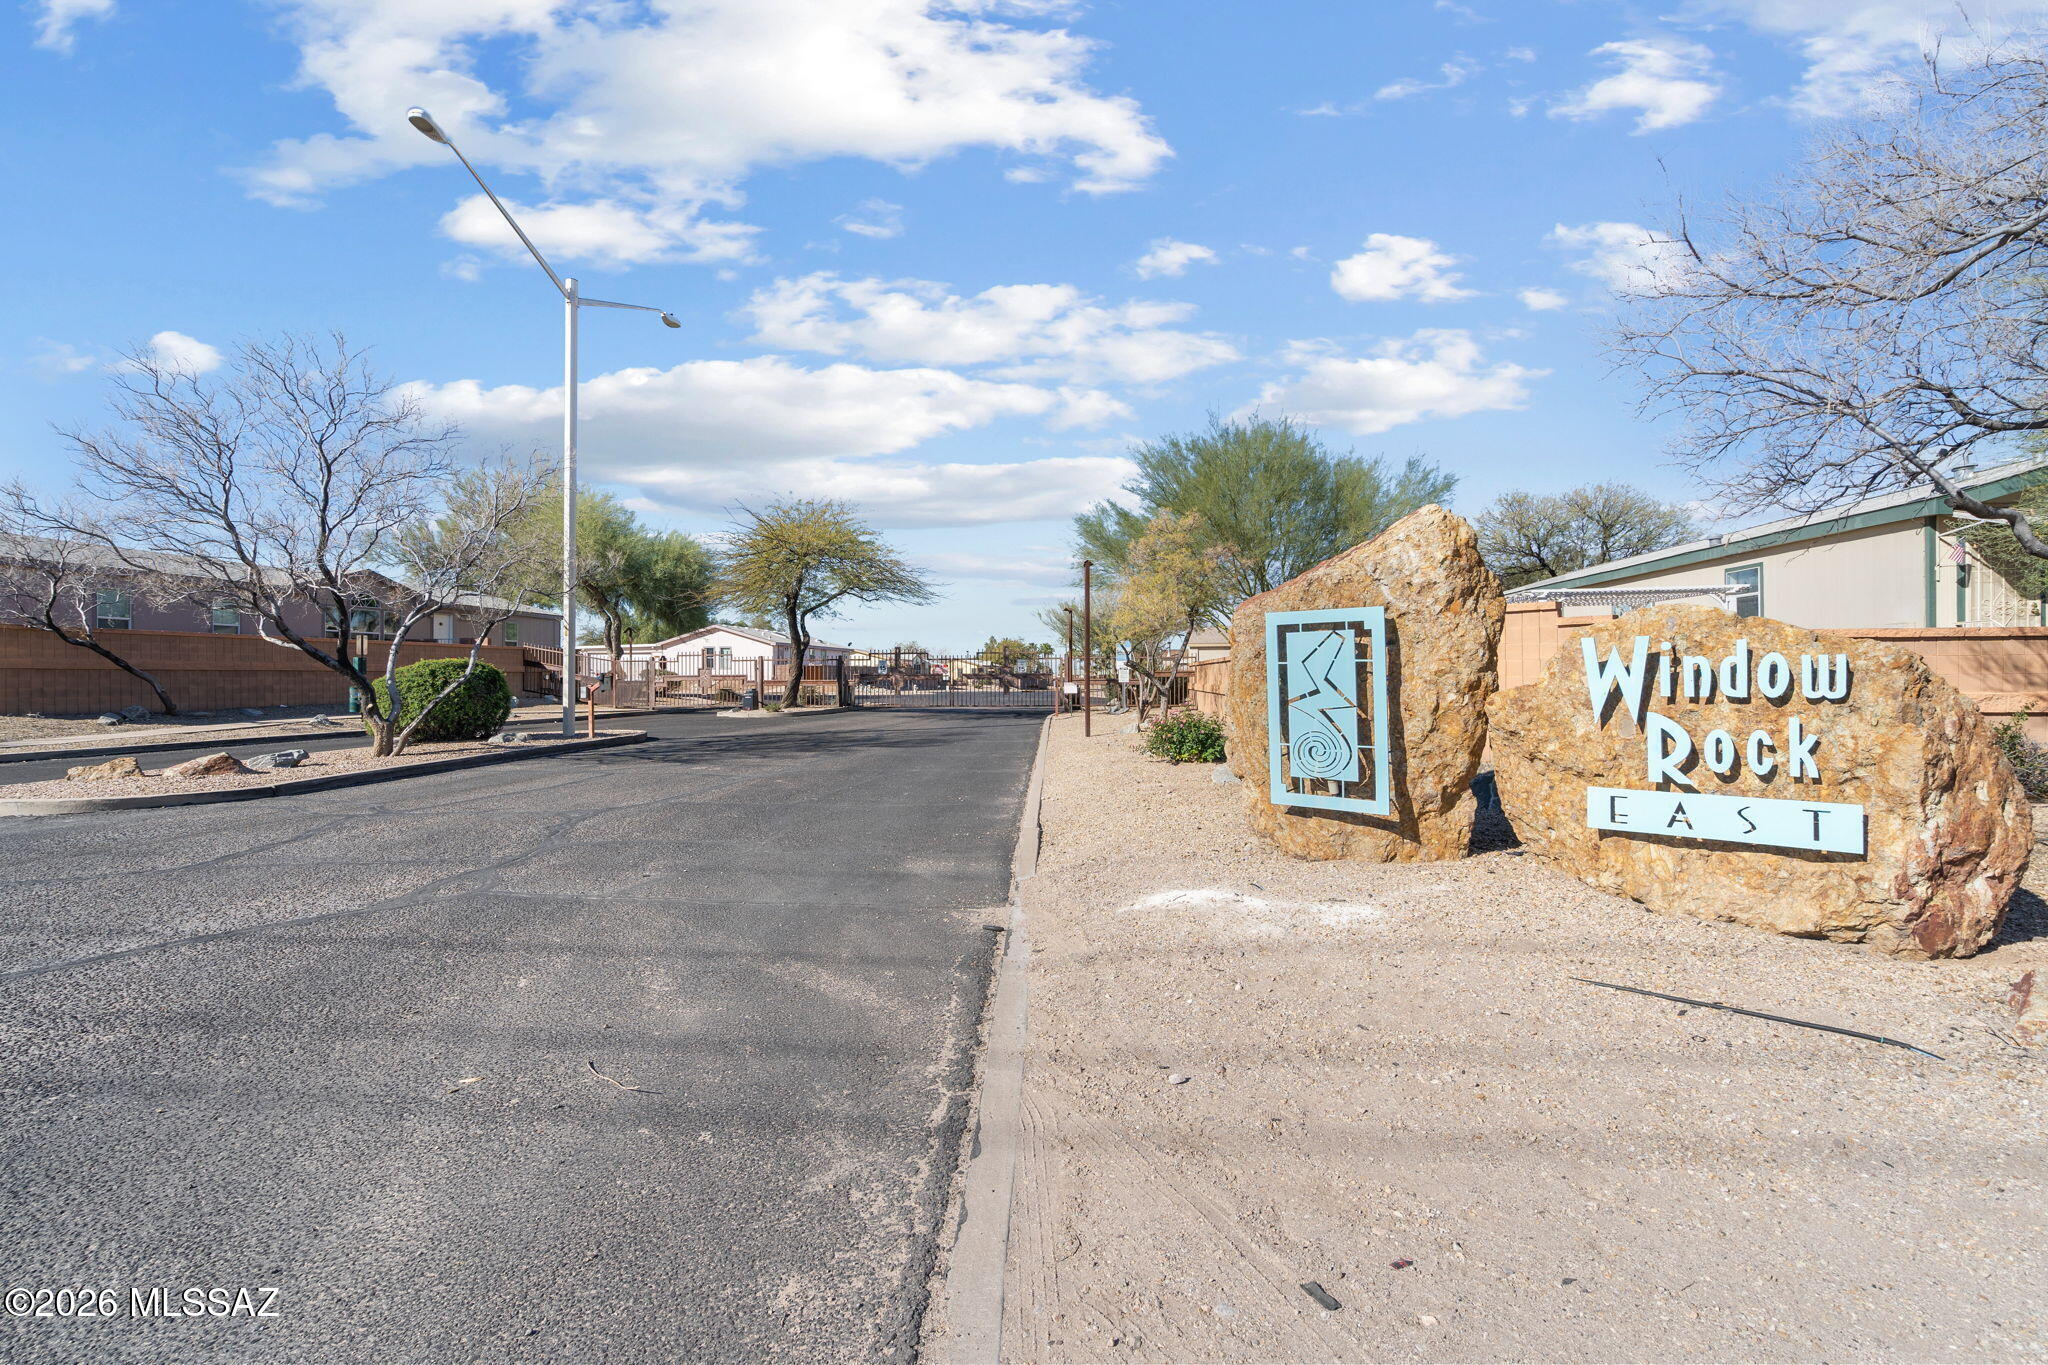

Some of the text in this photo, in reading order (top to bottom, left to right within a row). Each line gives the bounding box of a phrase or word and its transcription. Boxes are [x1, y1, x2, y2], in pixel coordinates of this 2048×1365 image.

[1581, 636, 1849, 725] Window
[1646, 712, 1819, 785] Rock
[1609, 795, 1831, 842] EAST
